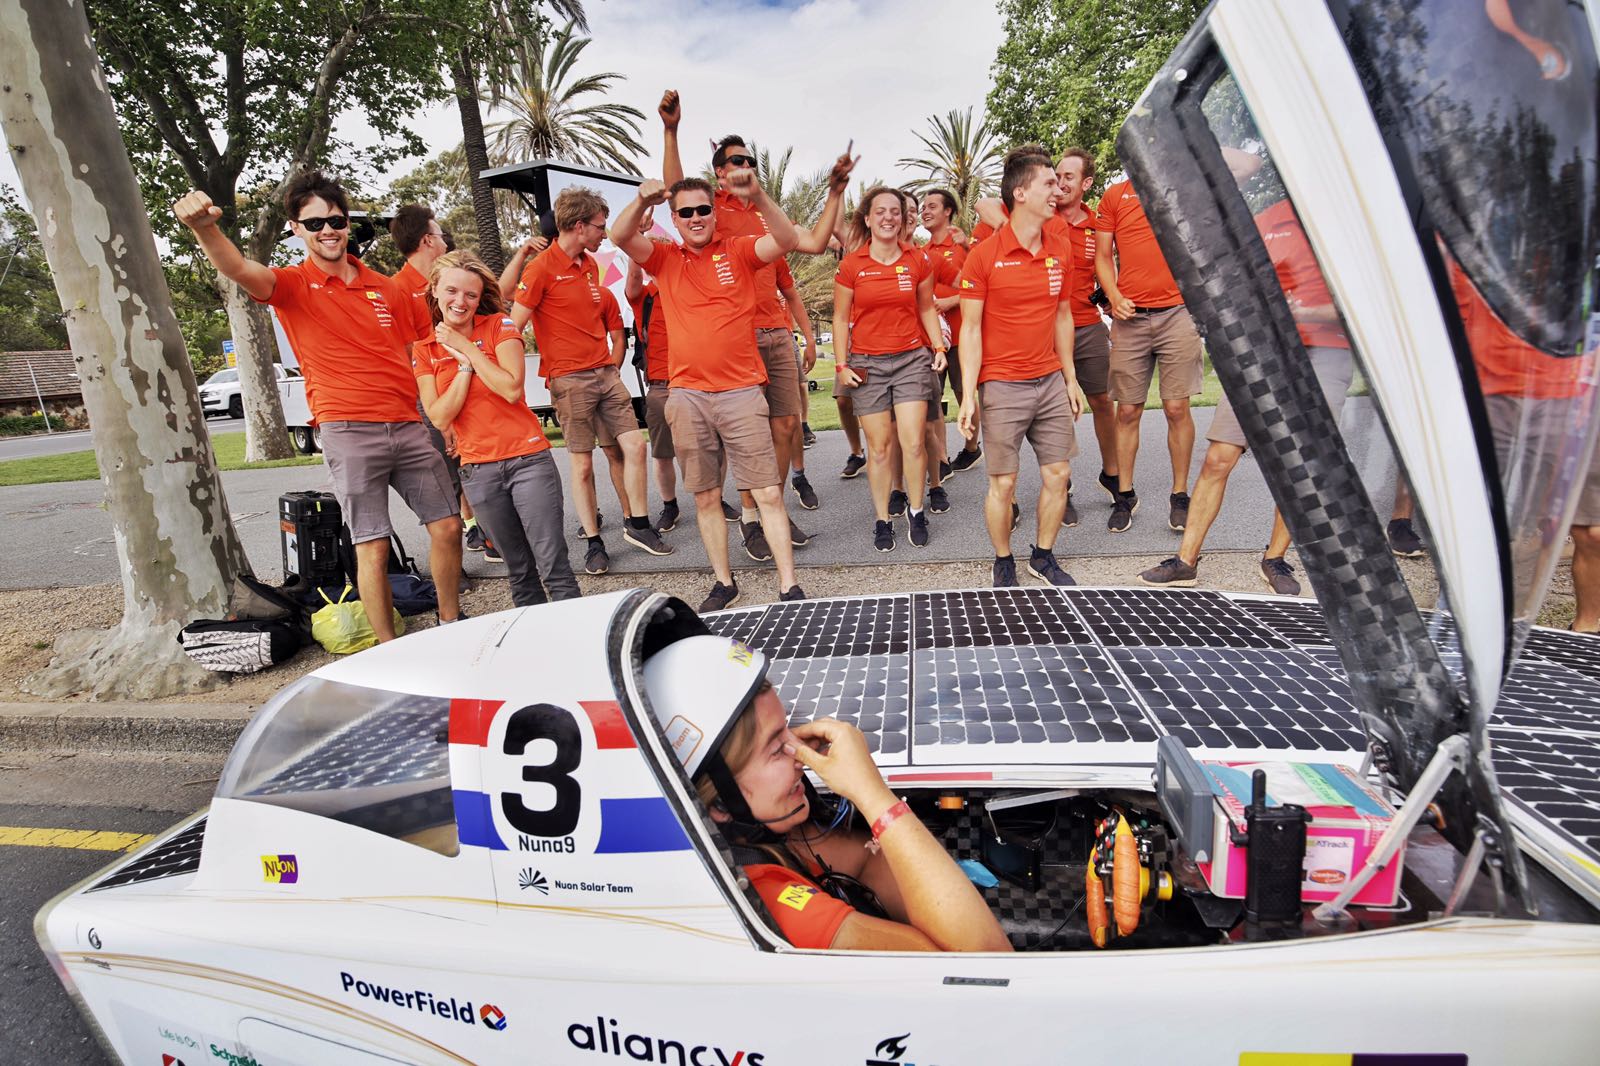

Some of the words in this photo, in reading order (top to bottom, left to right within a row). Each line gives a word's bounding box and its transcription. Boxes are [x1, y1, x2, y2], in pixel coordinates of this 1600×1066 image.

[501, 703, 582, 837] 3
[518, 834, 575, 853] Nuna9
[264, 860, 296, 877] NUON
[555, 880, 578, 890] Nuon
[581, 882, 605, 892] Solar
[606, 883, 633, 893] Team
[340, 971, 476, 1025] PowerField
[567, 1016, 765, 1066] aliancys
